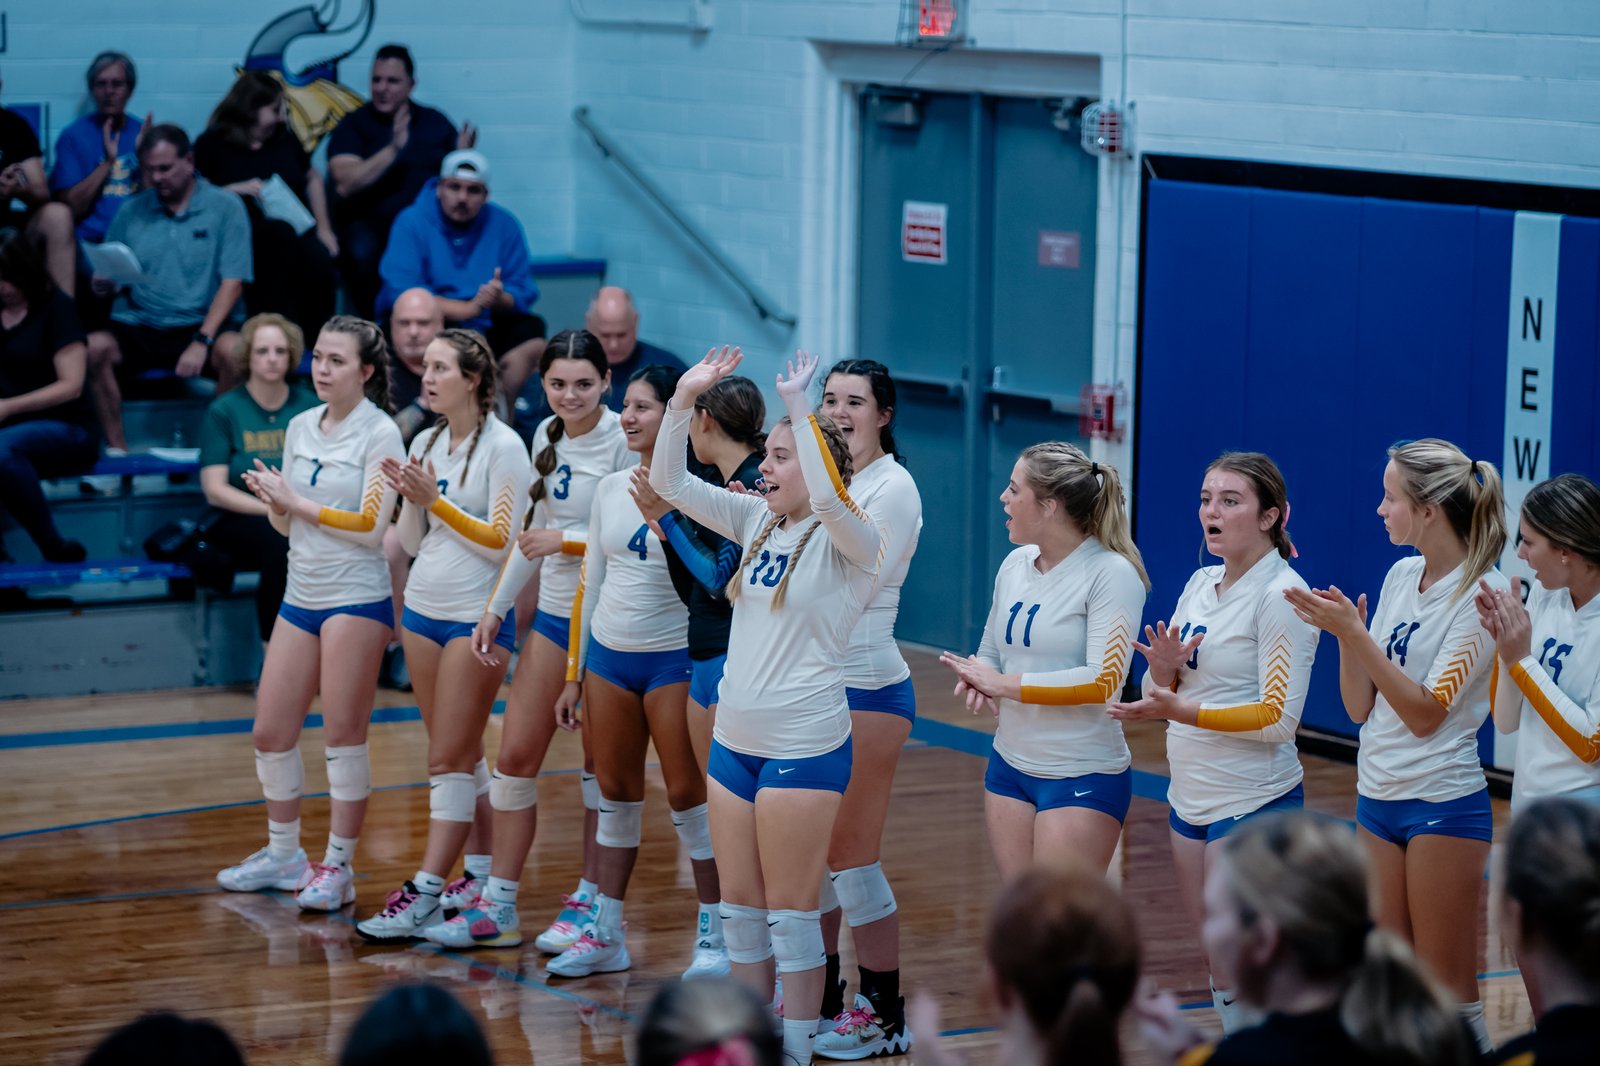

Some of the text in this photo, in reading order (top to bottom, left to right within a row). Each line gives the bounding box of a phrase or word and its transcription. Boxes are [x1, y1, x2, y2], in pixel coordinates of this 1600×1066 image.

[309, 457, 323, 487] 7
[553, 464, 572, 500] 3
[627, 523, 649, 561] 4
[750, 550, 789, 588] 10
[1005, 601, 1041, 648] 11
[1387, 621, 1420, 667] 14
[1538, 637, 1574, 686] 15
